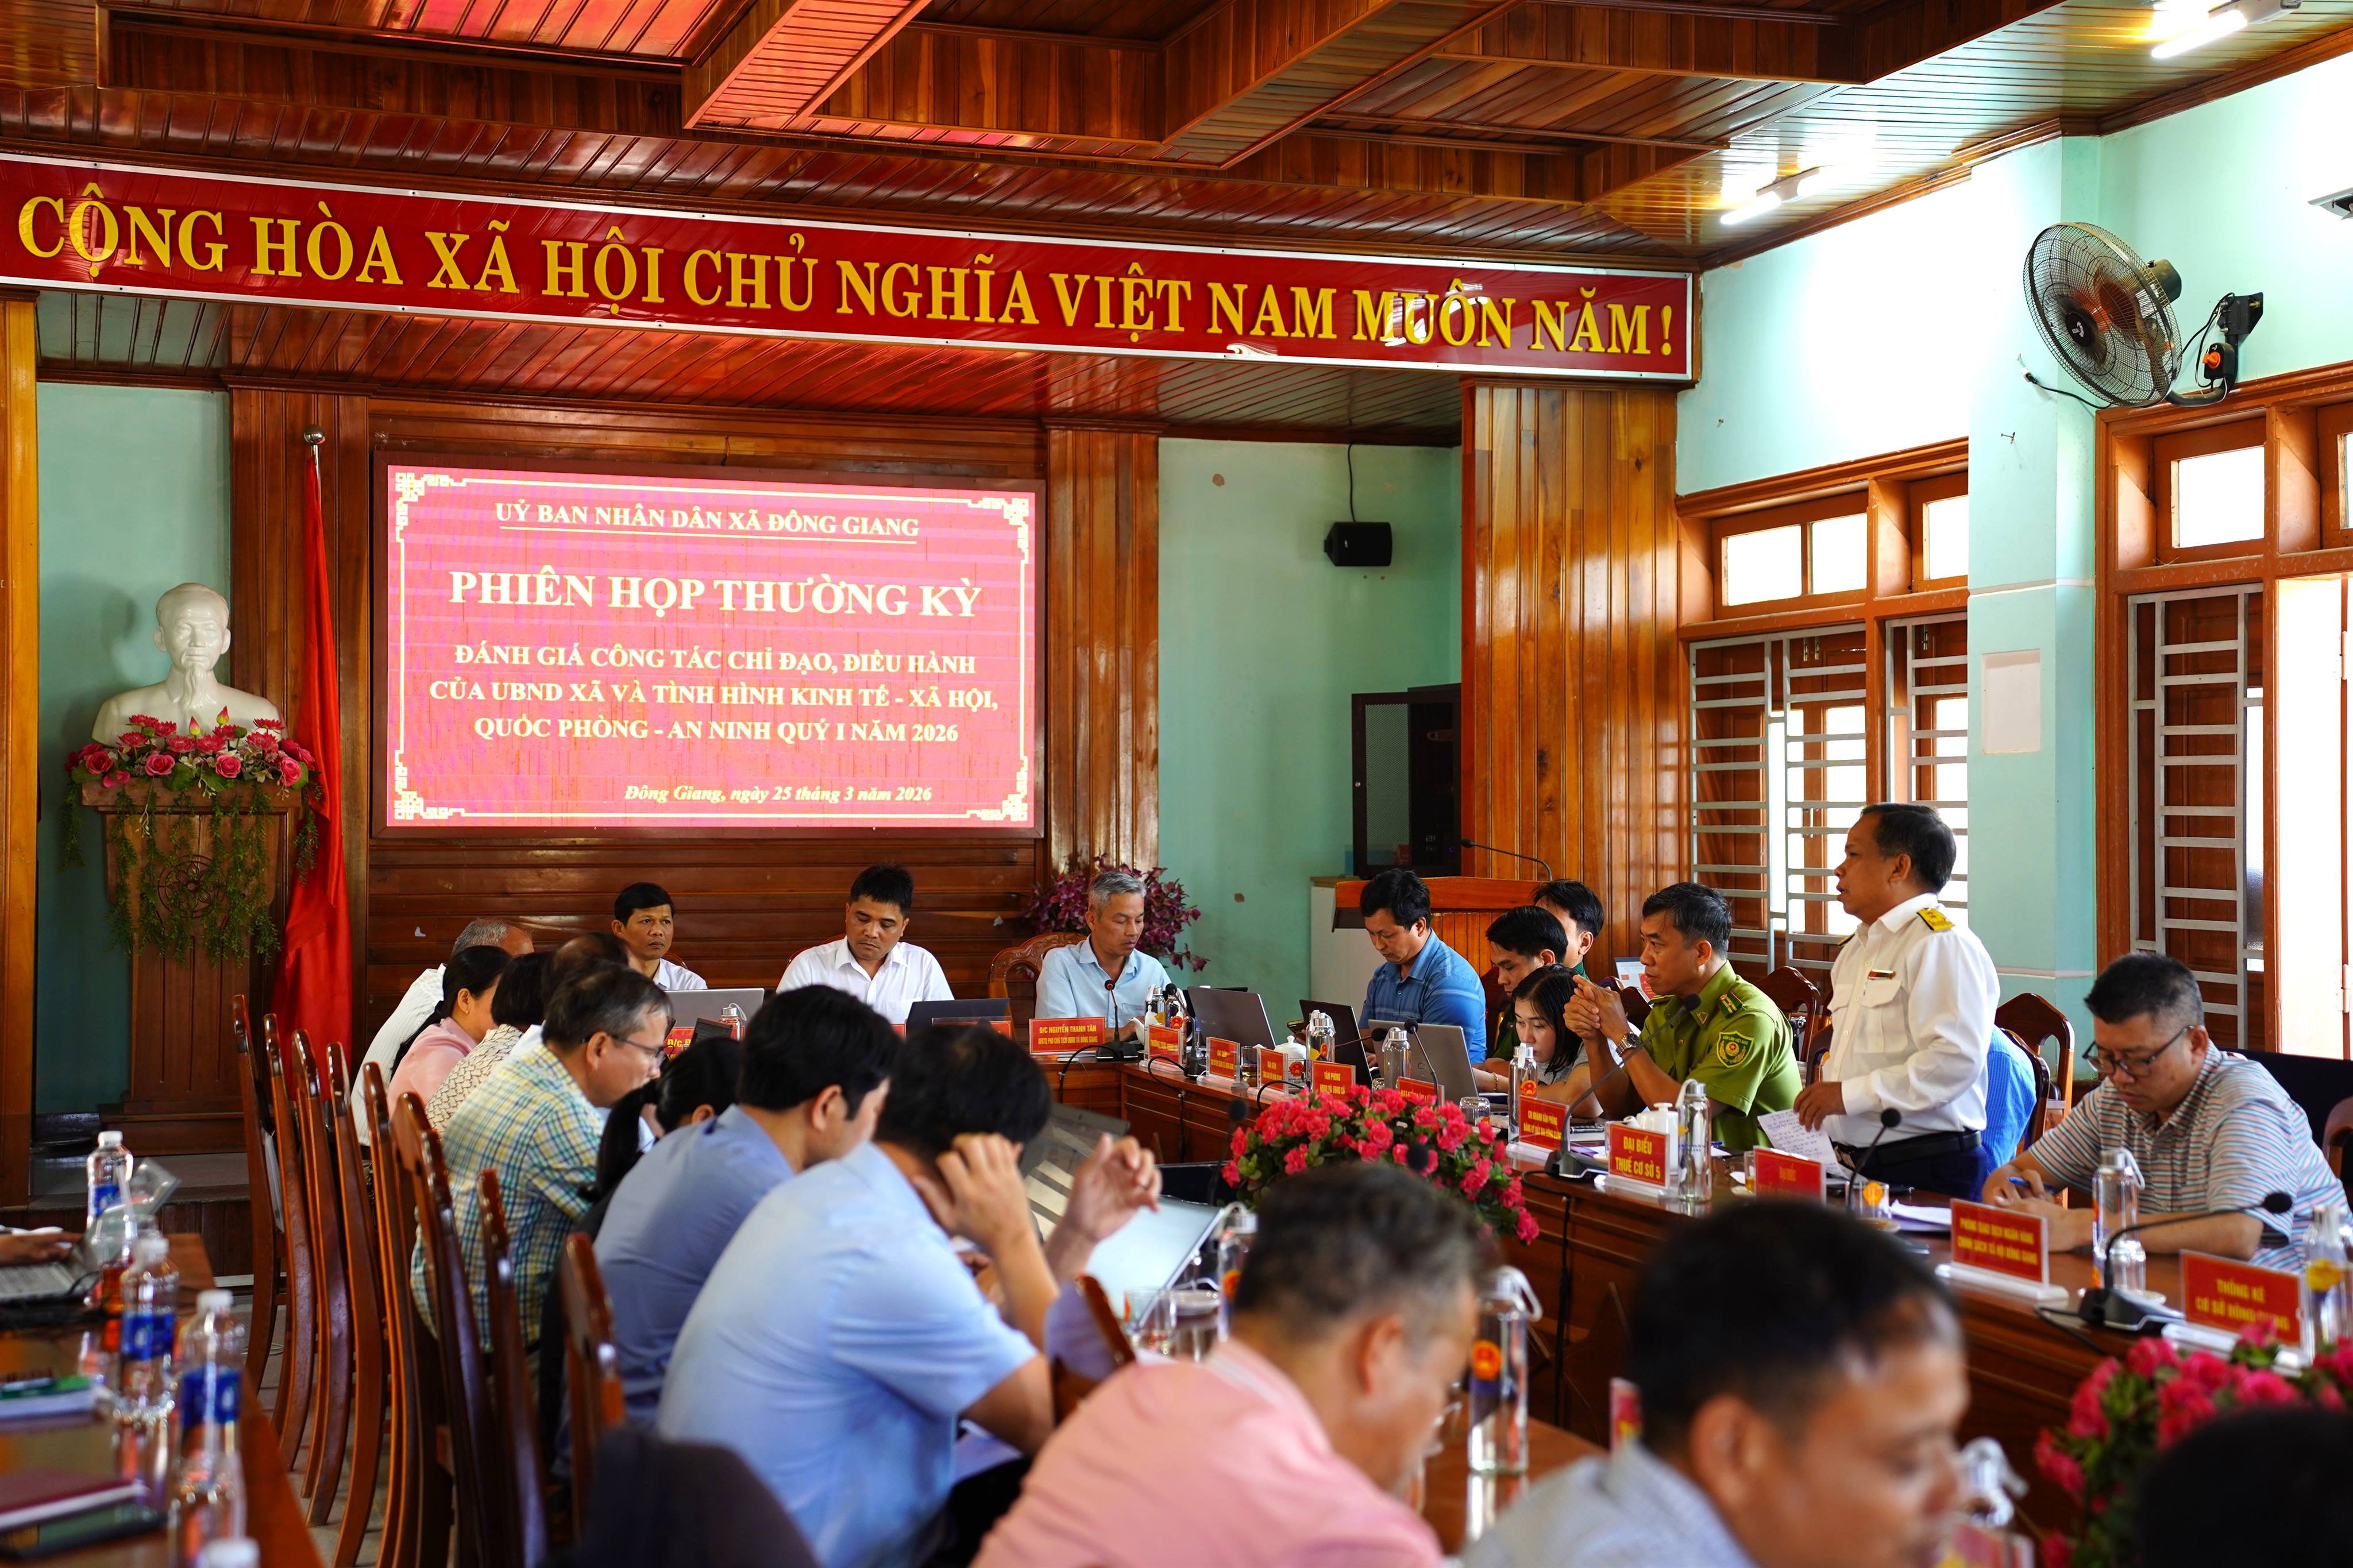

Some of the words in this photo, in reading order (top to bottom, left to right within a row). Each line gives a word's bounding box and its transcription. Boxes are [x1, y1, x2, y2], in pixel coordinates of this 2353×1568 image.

[19, 183, 227, 277] CỘNG
[250, 202, 403, 284] HÒA
[425, 220, 519, 293] XÃ
[542, 226, 664, 315] HỘI
[684, 233, 818, 311] CHỦ
[836, 254, 1039, 324] NGHĨA
[1050, 262, 1191, 342] VIỆT
[1208, 283, 1337, 338] NAM
[1353, 279, 1515, 348] MUÔN
[496, 499, 530, 521] UỶ
[538, 505, 587, 523] BAN
[595, 503, 664, 526] NHÂN
[671, 506, 722, 528] DÂN
[728, 509, 761, 530] XÃ
[767, 509, 836, 533] ĐÔNG
[842, 517, 919, 536] GIANG
[449, 565, 595, 607] PHIÊN
[608, 577, 704, 617] HỌP
[713, 574, 909, 615] THƯỜNG
[919, 578, 982, 616] KỲ
[455, 642, 530, 664] ĐÁNH
[537, 643, 584, 665] GIÁ
[591, 644, 664, 667] CÔNG
[670, 646, 721, 669] TÁC
[728, 647, 772, 670] CHỈ
[779, 652, 838, 675] ĐẠO,
[843, 650, 901, 672] ĐIỀU
[908, 651, 975, 673] HÀNH
[430, 677, 485, 700] CỦA
[491, 682, 560, 701] UBND
[569, 680, 604, 701] XÃ
[611, 681, 646, 702] VÀ
[653, 680, 714, 704] TÌNH
[721, 682, 784, 705] HÌNH
[790, 688, 853, 705] KINH
[859, 684, 889, 706] TẾ
[909, 686, 942, 707] XÃ
[948, 688, 997, 712] HỘI,
[558, 716, 648, 738] PHÒNG
[668, 721, 702, 739] AN
[709, 721, 771, 740] NINH
[777, 718, 830, 744] QUÝ
[836, 723, 844, 740] I
[851, 720, 906, 741] NĂM
[912, 724, 958, 741] 2026
[624, 785, 669, 803] Đông
[674, 786, 726, 803] Giang,
[730, 786, 769, 804] ngày
[772, 786, 792, 800] 25
[795, 786, 840, 804] tháng
[844, 786, 854, 800] 3
[857, 787, 892, 801] năm
[895, 787, 932, 801] 2026
[1049, 1024, 1069, 1033] NGUYỄN
[1086, 1024, 1097, 1032] TÂN
[1623, 1136, 1635, 1154] ĐẠI
[1636, 1135, 1652, 1155] BIỂU
[1615, 1155, 1633, 1173] THUẾ
[1633, 1160, 1644, 1175] CƠ
[1645, 1160, 1654, 1177] SỞ
[1656, 1165, 1661, 1180] 5
